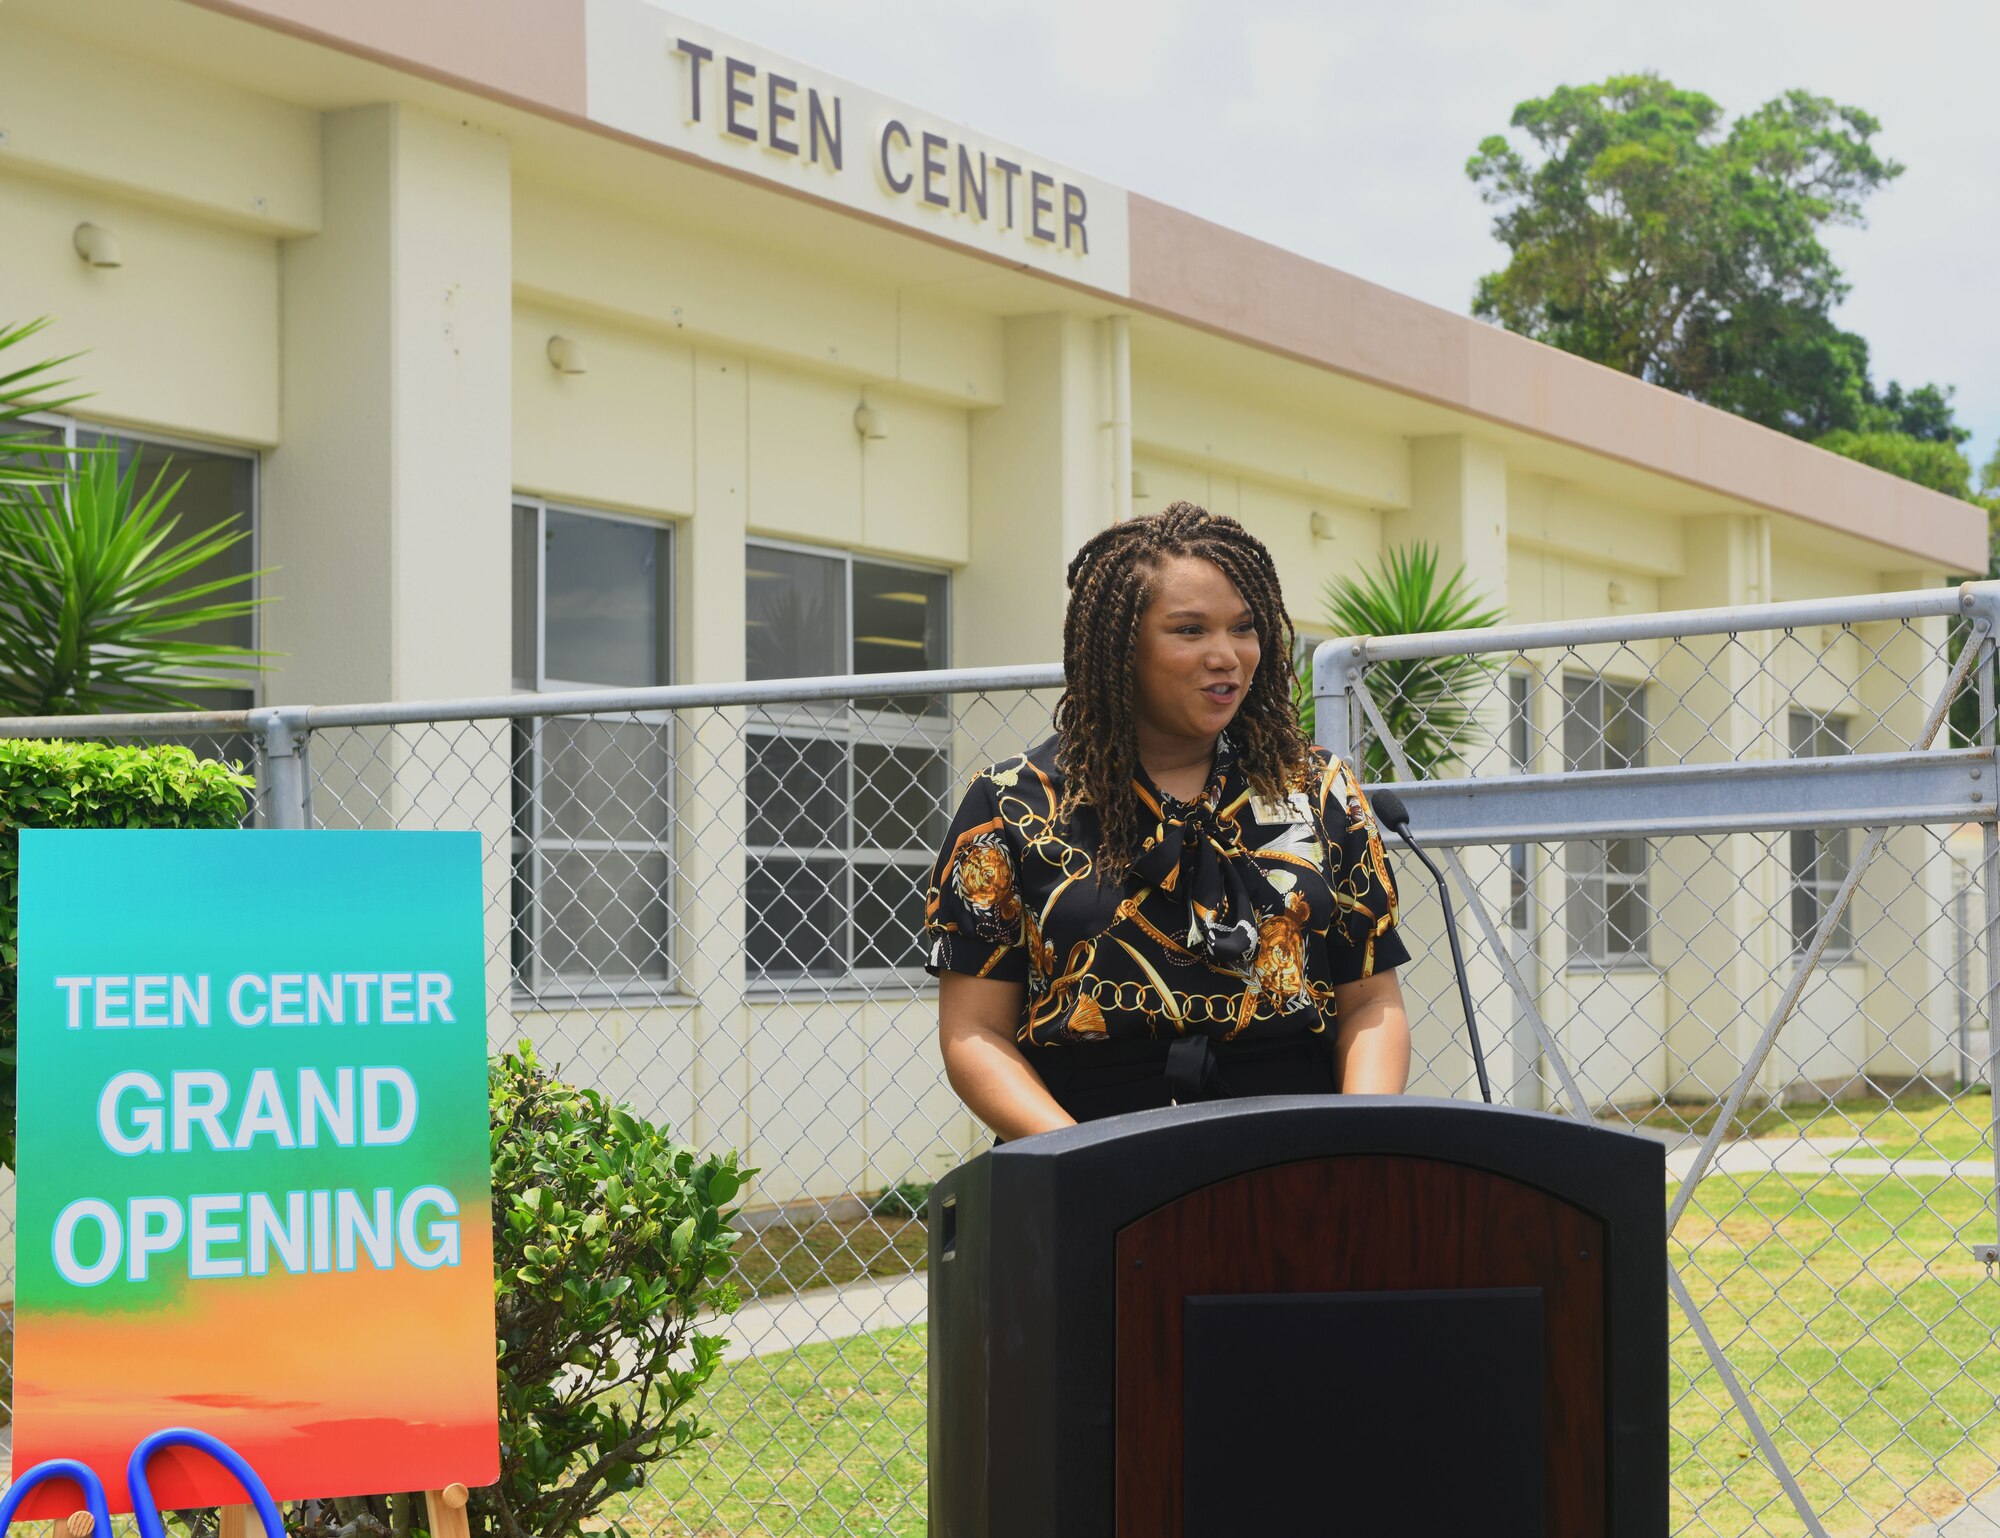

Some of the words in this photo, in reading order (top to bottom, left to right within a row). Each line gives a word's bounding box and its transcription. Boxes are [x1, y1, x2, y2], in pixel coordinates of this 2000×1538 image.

[672, 38, 842, 172] TEEN
[876, 119, 1089, 256] CENTER
[54, 973, 211, 1029] TEEN
[227, 971, 456, 1028] CENTER
[97, 1066, 418, 1155] GRAND
[52, 1185, 461, 1286] OPENING
